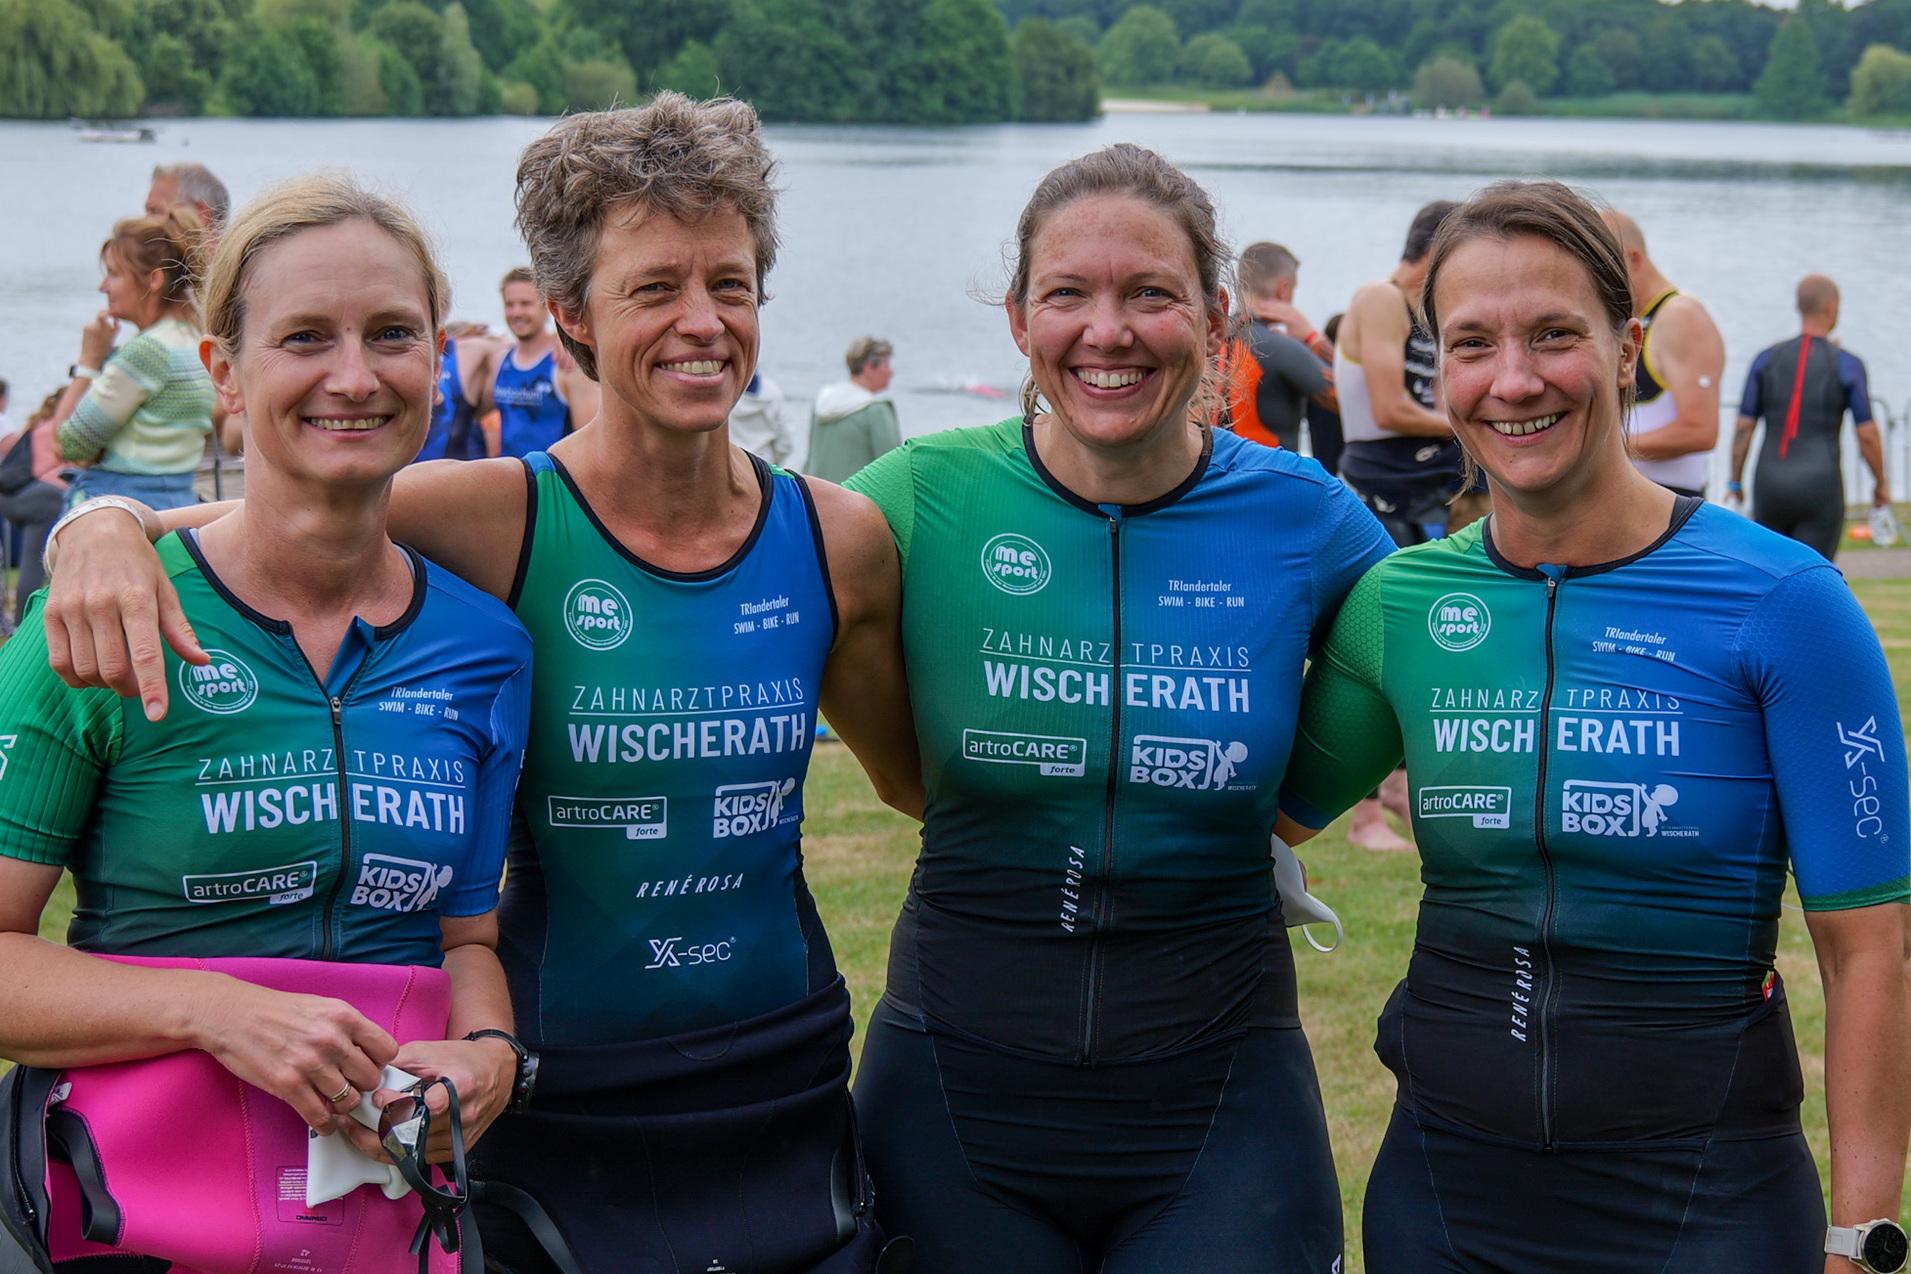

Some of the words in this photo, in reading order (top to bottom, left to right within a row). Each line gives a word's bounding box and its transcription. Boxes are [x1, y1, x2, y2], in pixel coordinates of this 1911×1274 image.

[995, 545, 1037, 567] me
[993, 562, 1038, 580] sport
[578, 594, 618, 616] me
[1158, 596, 1184, 607] SWIM
[1195, 597, 1215, 608] BIKE
[1226, 597, 1245, 607] RUN
[576, 615, 621, 631] sport
[733, 620, 755, 635] SWIM
[762, 615, 779, 630] BIKE
[785, 611, 799, 625] RUN
[1440, 606, 1478, 622] me
[1439, 621, 1479, 637] sport
[1592, 641, 1616, 653] SWIM
[1625, 645, 1647, 655] BIKE
[1655, 650, 1676, 662] RUN
[193, 663, 238, 682] me
[197, 678, 246, 698] sport
[571, 678, 804, 710] ZAHNARZTPRAXIS
[378, 701, 405, 713] SWIM
[414, 702, 436, 717] BIKE
[443, 706, 459, 721] RUN
[568, 713, 806, 763] WISCHERATH
[1132, 745, 1206, 770] KIDS
[1050, 766, 1076, 774] forte
[1129, 765, 1199, 789] BOX
[714, 792, 769, 817] KIDS
[1562, 791, 1632, 816] KIDS
[635, 827, 659, 837] forte
[713, 812, 763, 838] BOX
[1481, 817, 1502, 825] forte
[1562, 812, 1627, 837] BOX
[357, 865, 422, 893] KIDS
[350, 885, 410, 911] BOX
